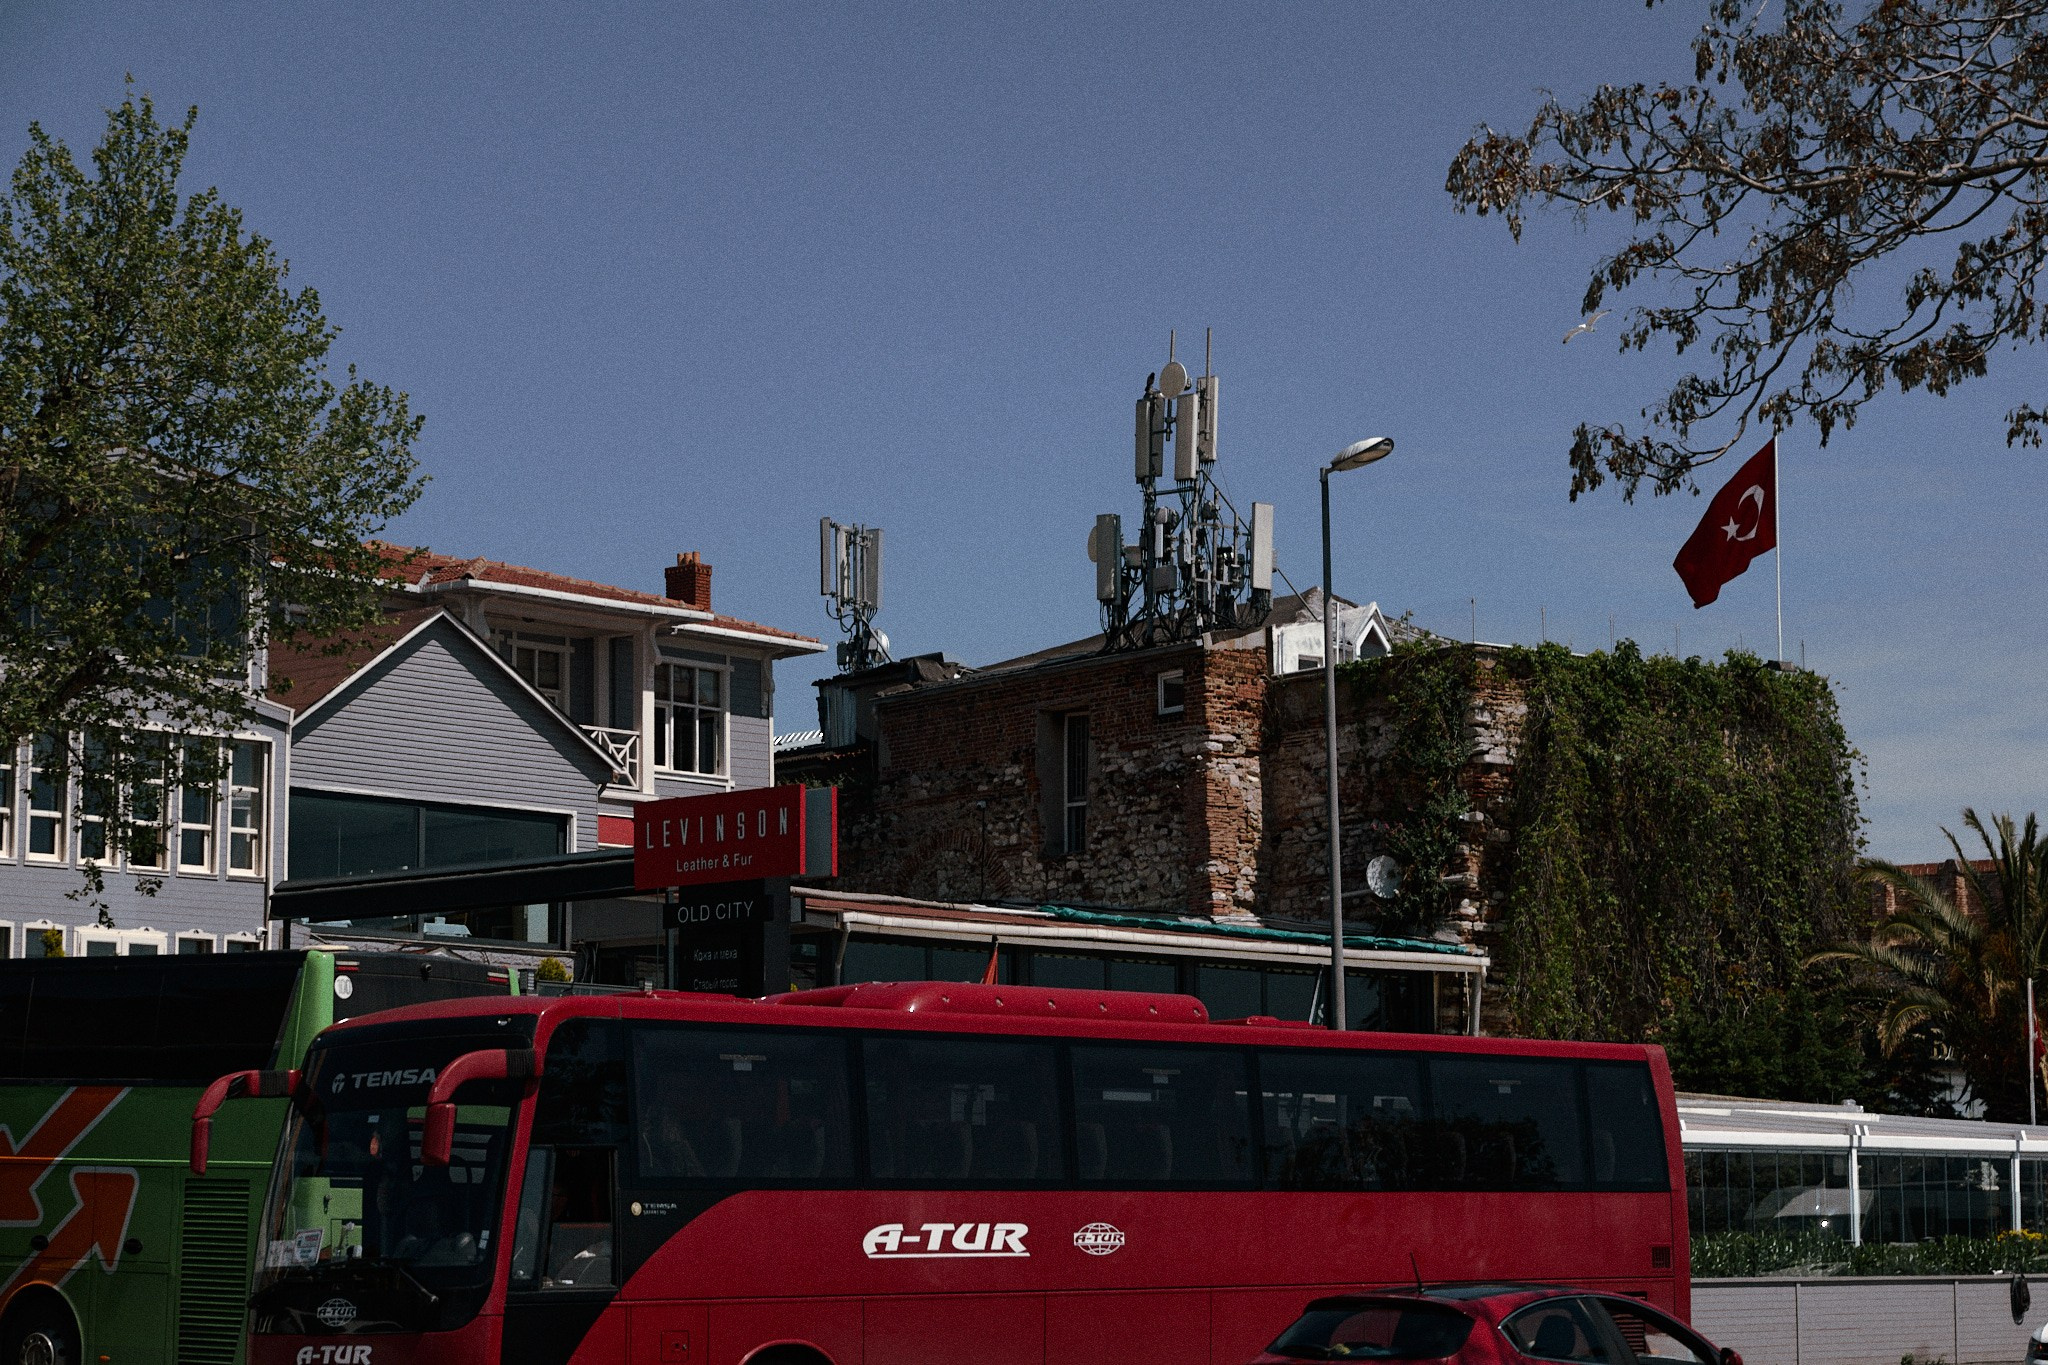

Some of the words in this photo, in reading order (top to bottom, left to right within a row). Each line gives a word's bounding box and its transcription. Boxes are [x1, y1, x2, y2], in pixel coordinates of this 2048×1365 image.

[646, 807, 788, 849] LEVINSON
[676, 855, 718, 872] Leather
[722, 855, 730, 868] &
[733, 853, 753, 867] Fur
[677, 905, 710, 923] OLD
[715, 901, 754, 920] CITY
[352, 1068, 436, 1089] TEMSA
[863, 1223, 1029, 1254] A-TUR
[1075, 1233, 1124, 1244] A-TUR
[320, 1307, 356, 1317] A-TUR
[297, 1345, 372, 1365] A-TUR
